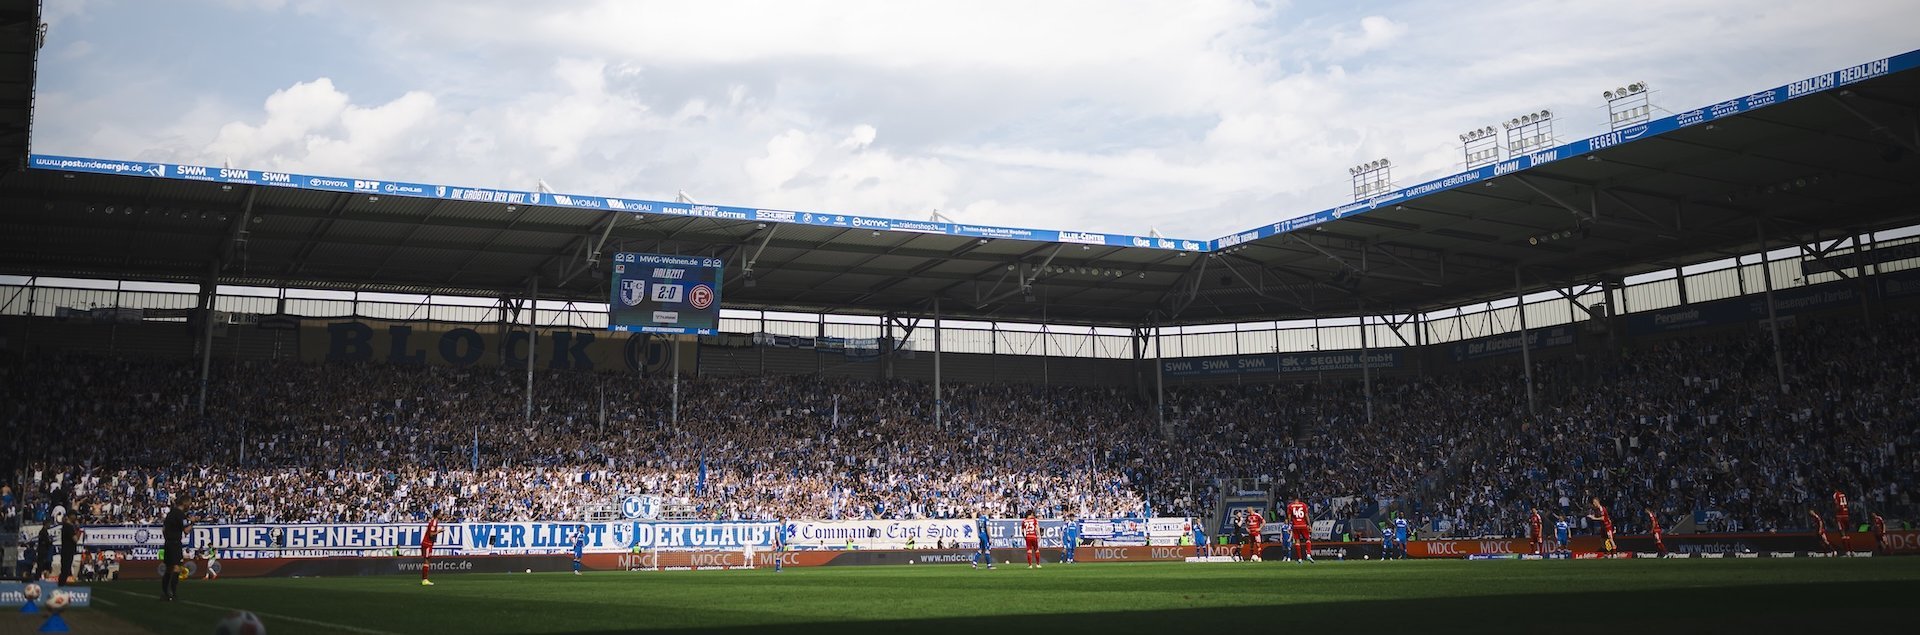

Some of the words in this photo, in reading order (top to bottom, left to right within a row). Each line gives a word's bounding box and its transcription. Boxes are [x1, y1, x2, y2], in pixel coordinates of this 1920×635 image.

[1840, 59, 1889, 83] REDLICH
[1788, 73, 1835, 96] REDLICH
[1590, 131, 1622, 150] FEGERT
[1532, 151, 1557, 166] ÖHMI
[36, 158, 143, 172] www.postundenergie.de
[177, 165, 206, 176] SWM
[1494, 161, 1519, 176] ÖHMI
[220, 169, 249, 179] SWM
[262, 172, 290, 182] SWM
[354, 180, 380, 189] DIT
[1406, 182, 1442, 197] GARTEMANN
[1443, 172, 1480, 187] GERÜSTBAU
[451, 189, 464, 199] DIE
[493, 192, 508, 202] DER
[508, 193, 526, 203] WELT
[572, 199, 600, 207] WOBAU
[624, 203, 652, 211] WOBAU
[663, 207, 687, 215] BADEN
[689, 208, 703, 216] WIE
[704, 209, 717, 217] DIE
[718, 209, 746, 219] GÖTTER
[756, 210, 795, 219] SCHUBERT
[1059, 231, 1105, 241] ALLEE-CENTER
[640, 256, 698, 266] MWG-Wohnen.de
[652, 268, 685, 279] HALBZEIT
[658, 286, 676, 299] 2:0
[1774, 296, 1822, 311] liesenprofi
[1468, 343, 1485, 354] Der
[1486, 331, 1539, 351] Küchencef
[328, 331, 595, 370] BLOCK
[1202, 360, 1229, 370] SWM
[1238, 358, 1265, 368] SWM
[1310, 355, 1354, 365] SEGUIN
[1165, 362, 1192, 371] SWM
[1293, 507, 1304, 519] 46
[802, 523, 881, 539] Commando
[887, 522, 922, 539] East
[927, 523, 959, 538] Side
[989, 522, 1005, 537] ür
[1024, 522, 1035, 532] 23
[287, 525, 462, 547] GENERATN
[469, 524, 526, 548] WER
[532, 524, 606, 548] LIEBT
[639, 523, 686, 546] DER
[1152, 548, 1183, 558] MDCC
[1209, 547, 1238, 557] MDC
[1427, 542, 1459, 555] MDCC
[1480, 541, 1513, 554] MDCC
[1679, 542, 1747, 553] www.mdcc.de
[920, 553, 976, 563] www.mdcc.d
[1095, 549, 1128, 559] MDCC
[619, 555, 660, 568] MDCC
[691, 554, 732, 567] MDCC
